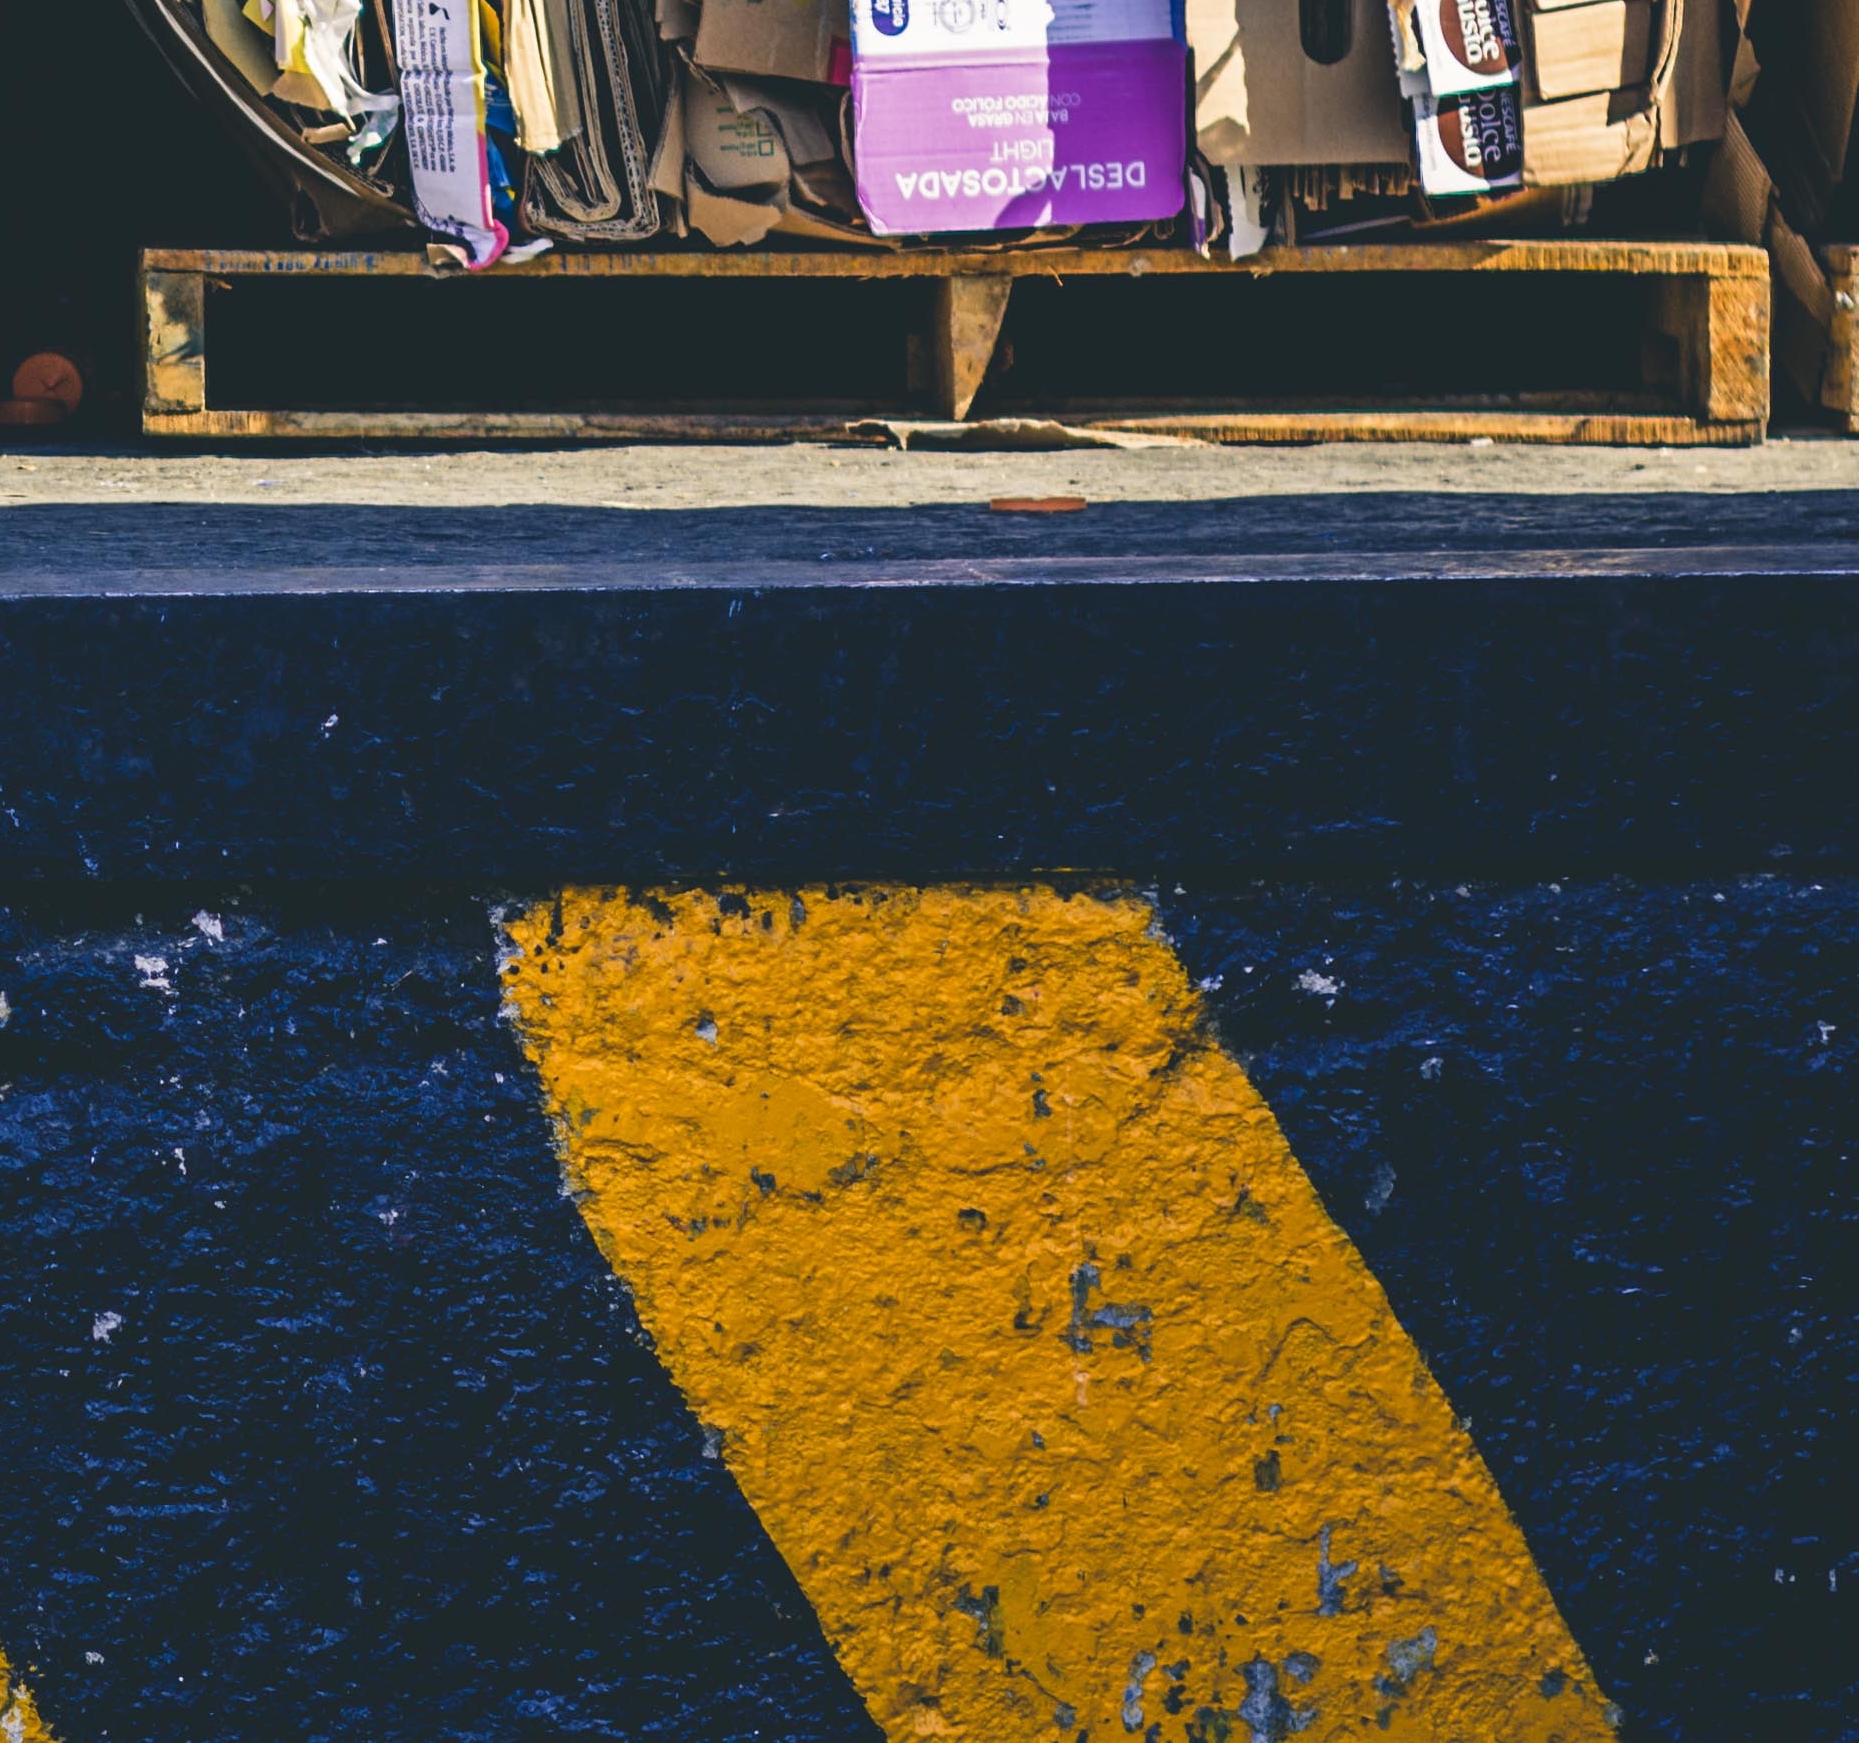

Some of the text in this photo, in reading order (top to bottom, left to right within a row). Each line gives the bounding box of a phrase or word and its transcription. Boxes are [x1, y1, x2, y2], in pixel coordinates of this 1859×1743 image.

[951, 93, 1082, 114] CON ÁCIDO FÓLICO
[967, 109, 1069, 129] BAJA EN GRASA
[990, 138, 1055, 162] LIGHT
[894, 161, 1147, 201] DESLACTOSADA
